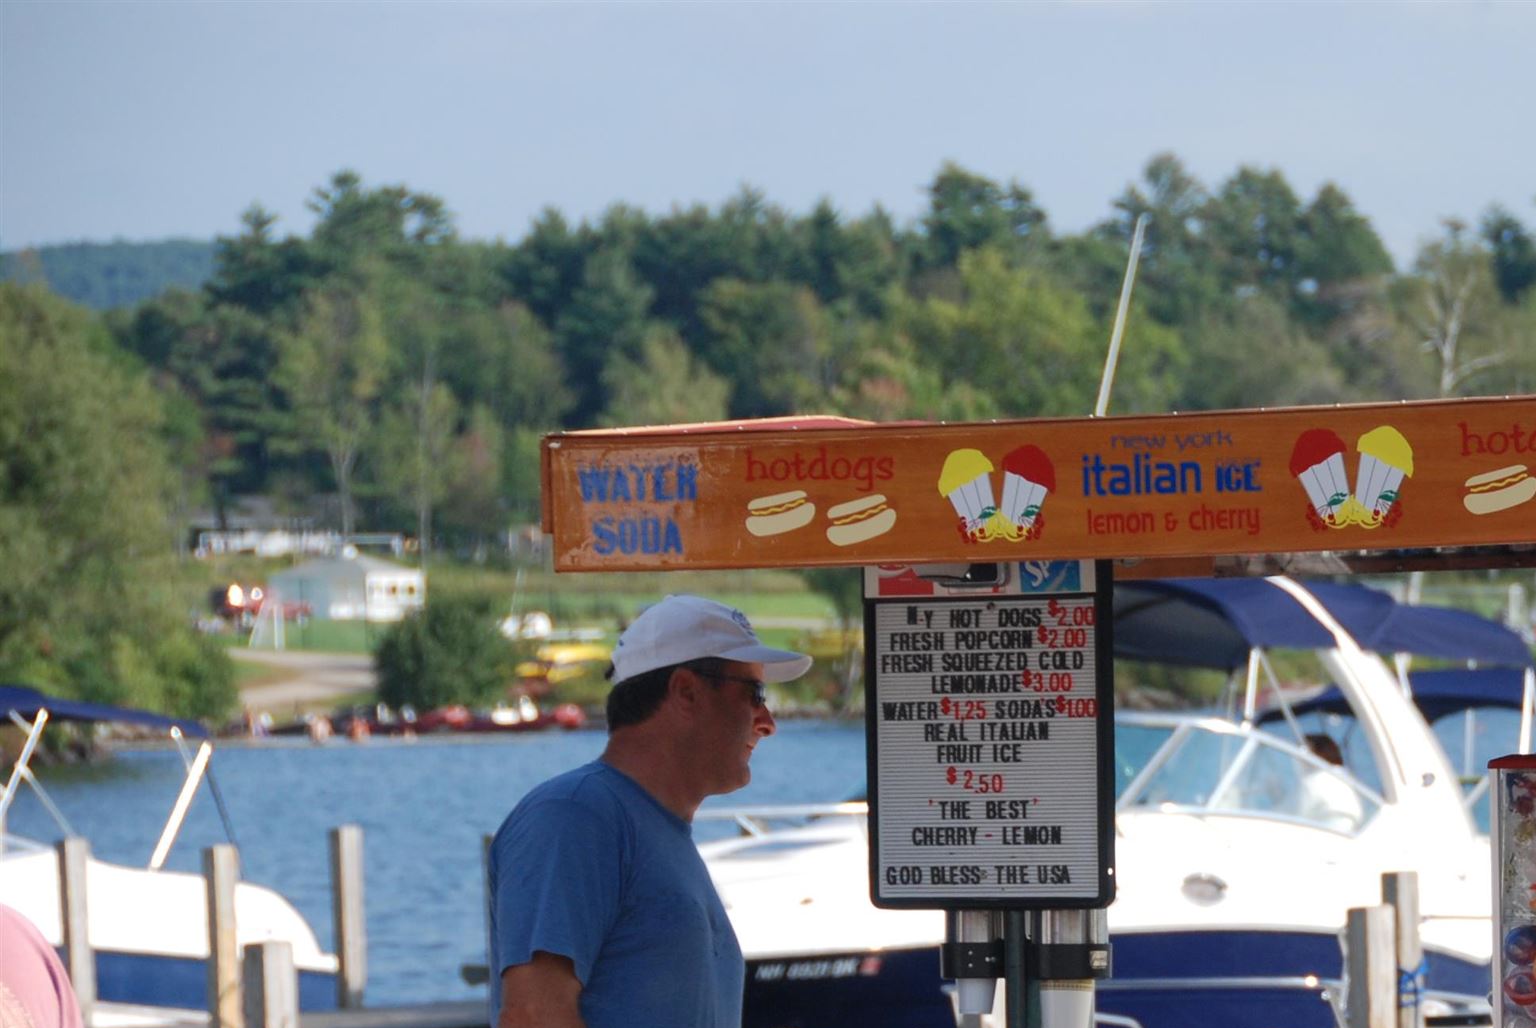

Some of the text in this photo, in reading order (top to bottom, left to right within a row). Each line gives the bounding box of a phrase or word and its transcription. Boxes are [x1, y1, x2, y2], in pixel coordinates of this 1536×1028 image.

[1110, 429, 1233, 451] new york
[577, 457, 699, 503] WATER
[745, 448, 895, 492] hotdogs
[1082, 453, 1202, 496] italian
[1087, 504, 1261, 536] lemon & cherry
[592, 514, 684, 555] SODA
[950, 609, 982, 628] HOT
[998, 608, 1042, 628] DOGS
[1048, 600, 1097, 626] $2.00
[890, 625, 1087, 650] FRESH POPCORN $2.00
[881, 651, 1084, 673] FRESH SQUEEZED COLD
[932, 669, 1073, 694] LEMONADE $3.00
[882, 701, 939, 721] WATER
[924, 721, 1049, 742] REAL ITALIAN
[937, 743, 1022, 763] FRUIT ICE
[912, 826, 978, 846] CHERRY
[1002, 826, 1062, 845] LEMON
[887, 864, 1071, 885] GOD BLESS THE USA
